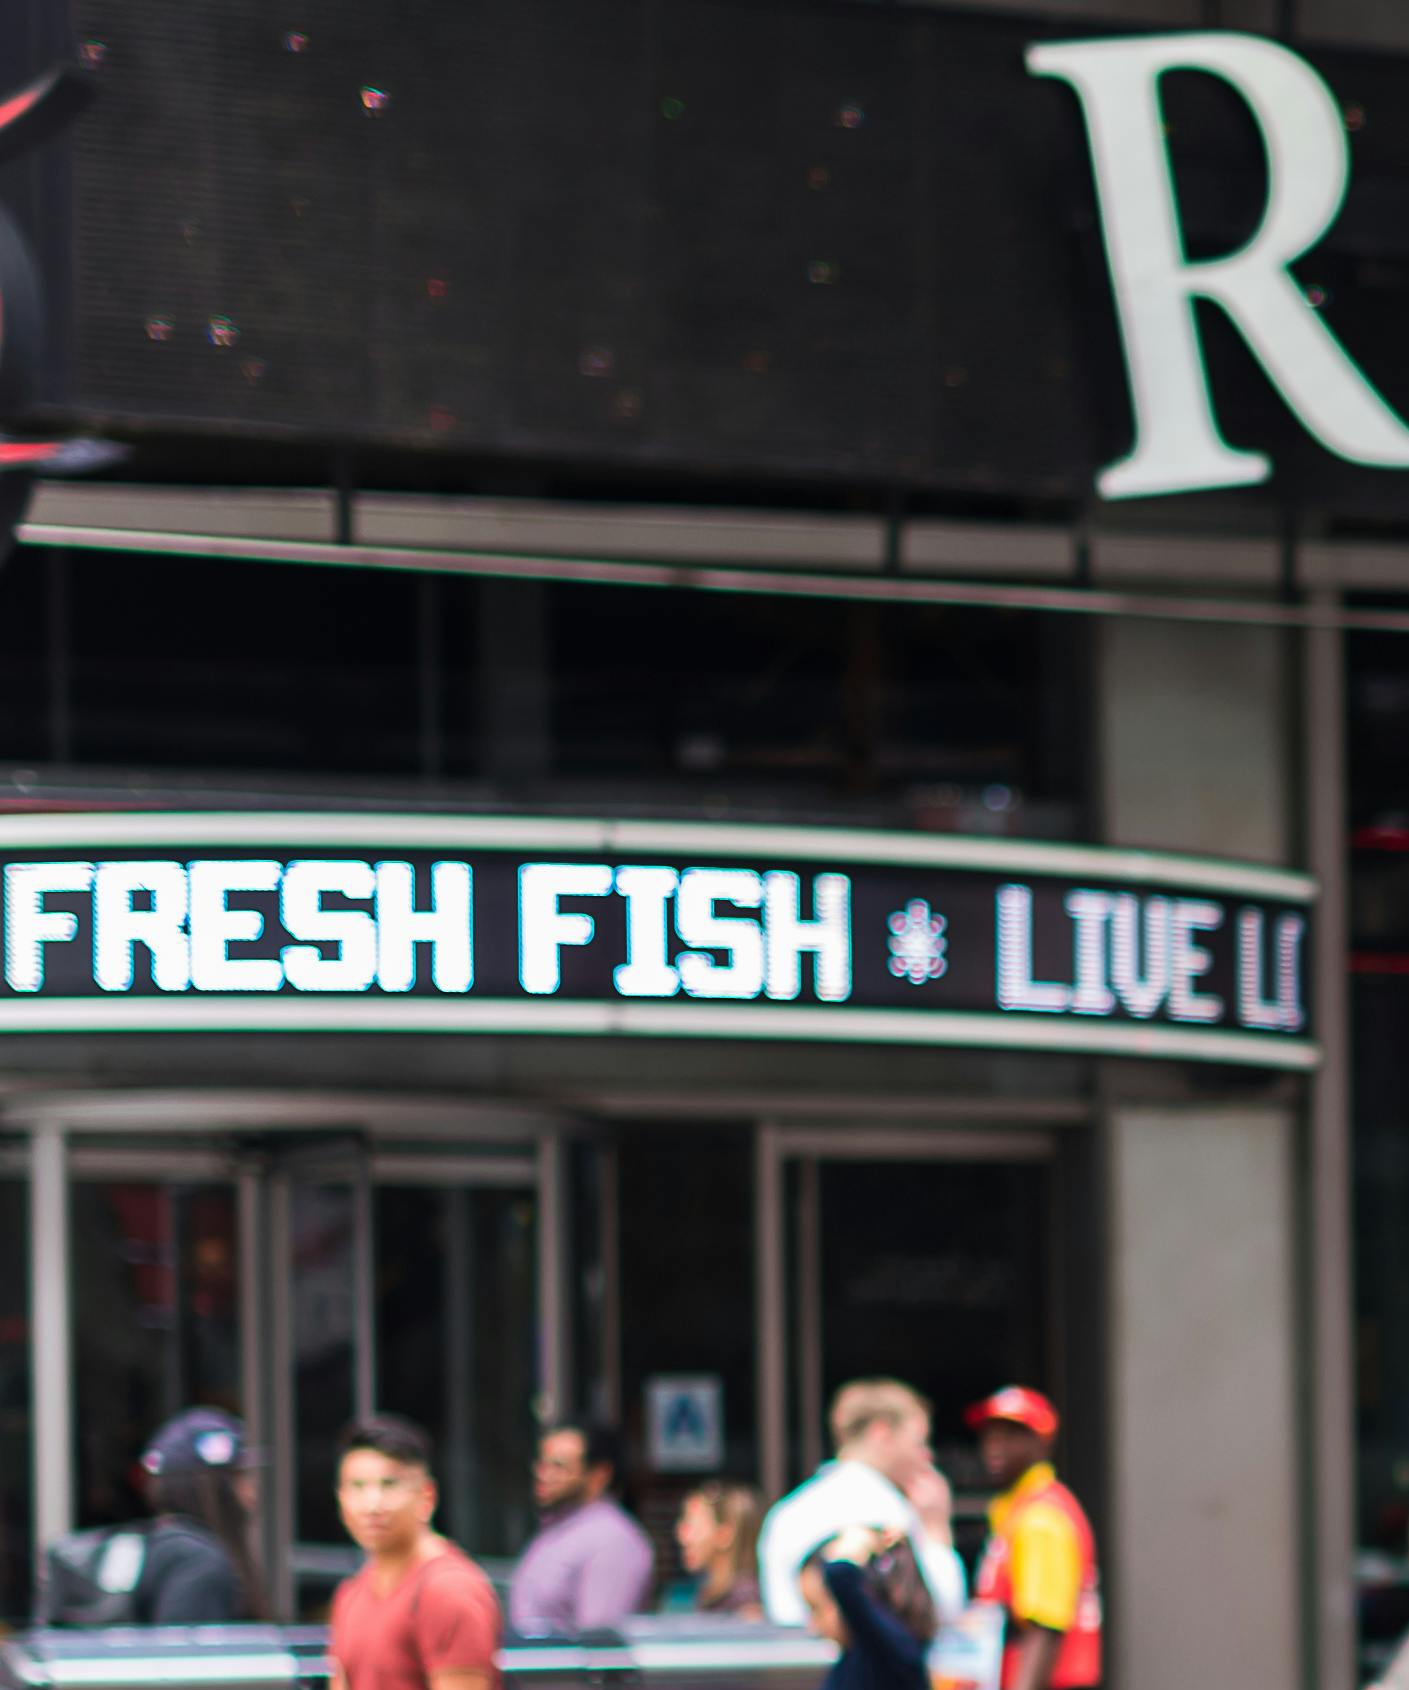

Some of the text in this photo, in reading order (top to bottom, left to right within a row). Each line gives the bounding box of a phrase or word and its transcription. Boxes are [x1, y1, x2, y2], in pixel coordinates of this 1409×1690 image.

[2, 858, 476, 994] FRESH
[516, 861, 854, 1004] FISH
[996, 883, 1223, 1024] LIVE
